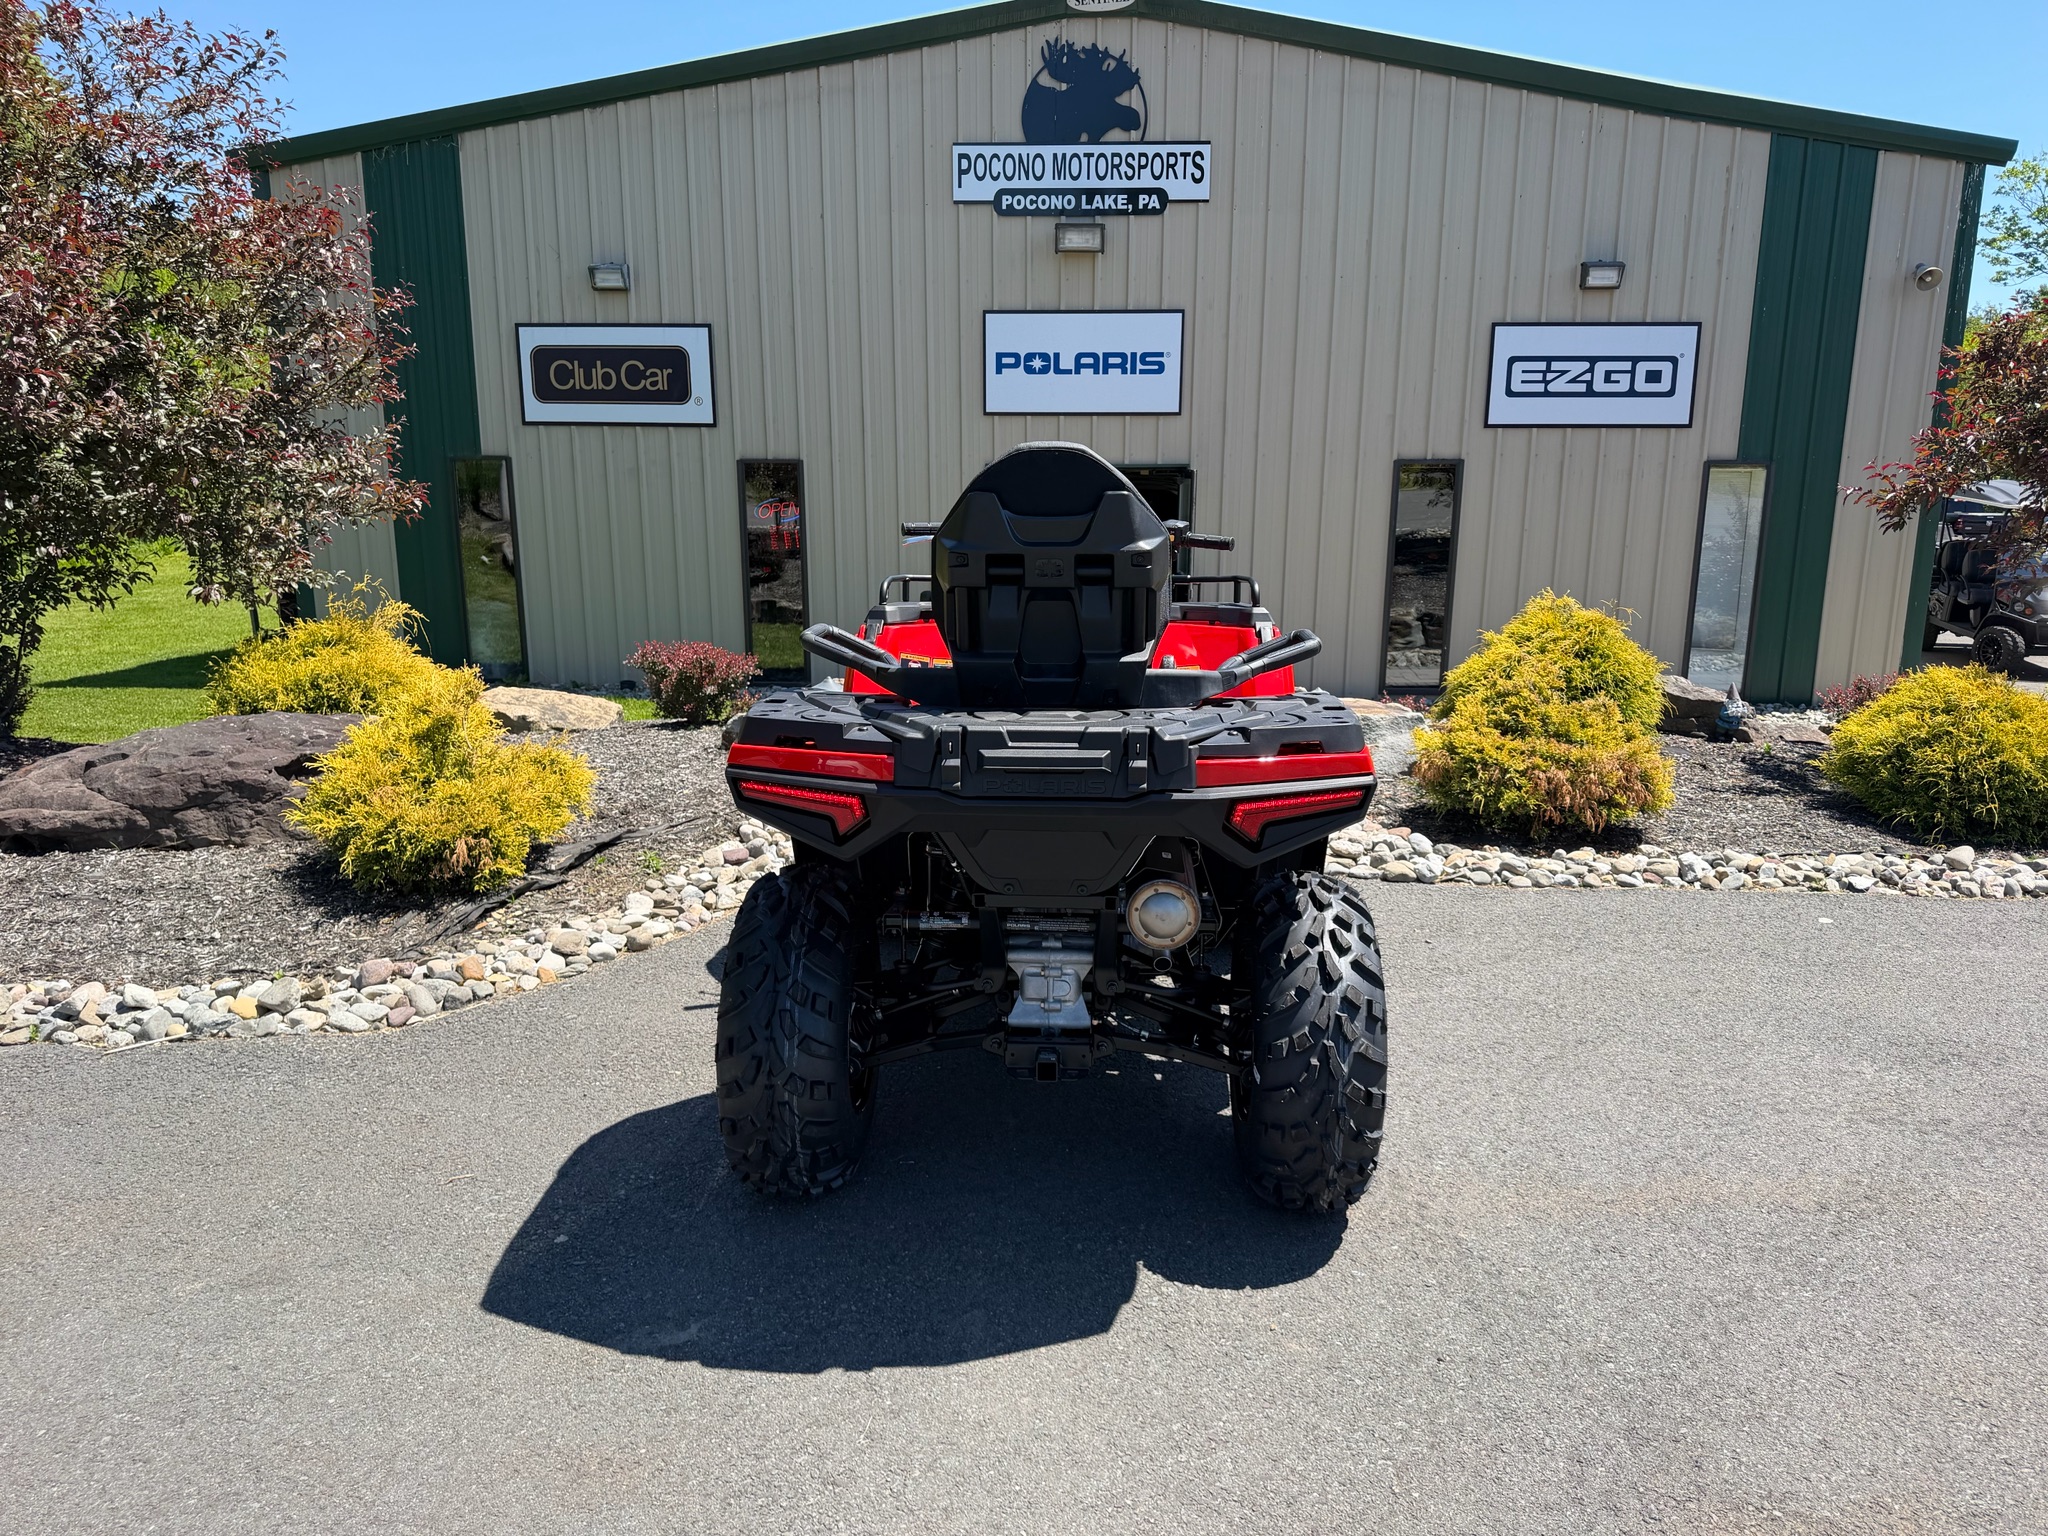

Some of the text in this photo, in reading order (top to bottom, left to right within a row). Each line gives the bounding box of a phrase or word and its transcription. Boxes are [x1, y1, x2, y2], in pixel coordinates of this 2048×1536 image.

[957, 151, 1205, 188] POCONO MOTORSPORTS
[1001, 194, 1161, 213] POCONO LAKE, PA
[995, 351, 1166, 375] POLARIS
[549, 359, 673, 391] Club Car
[758, 501, 800, 519] OPEN
[982, 778, 1107, 795] POLARIS
